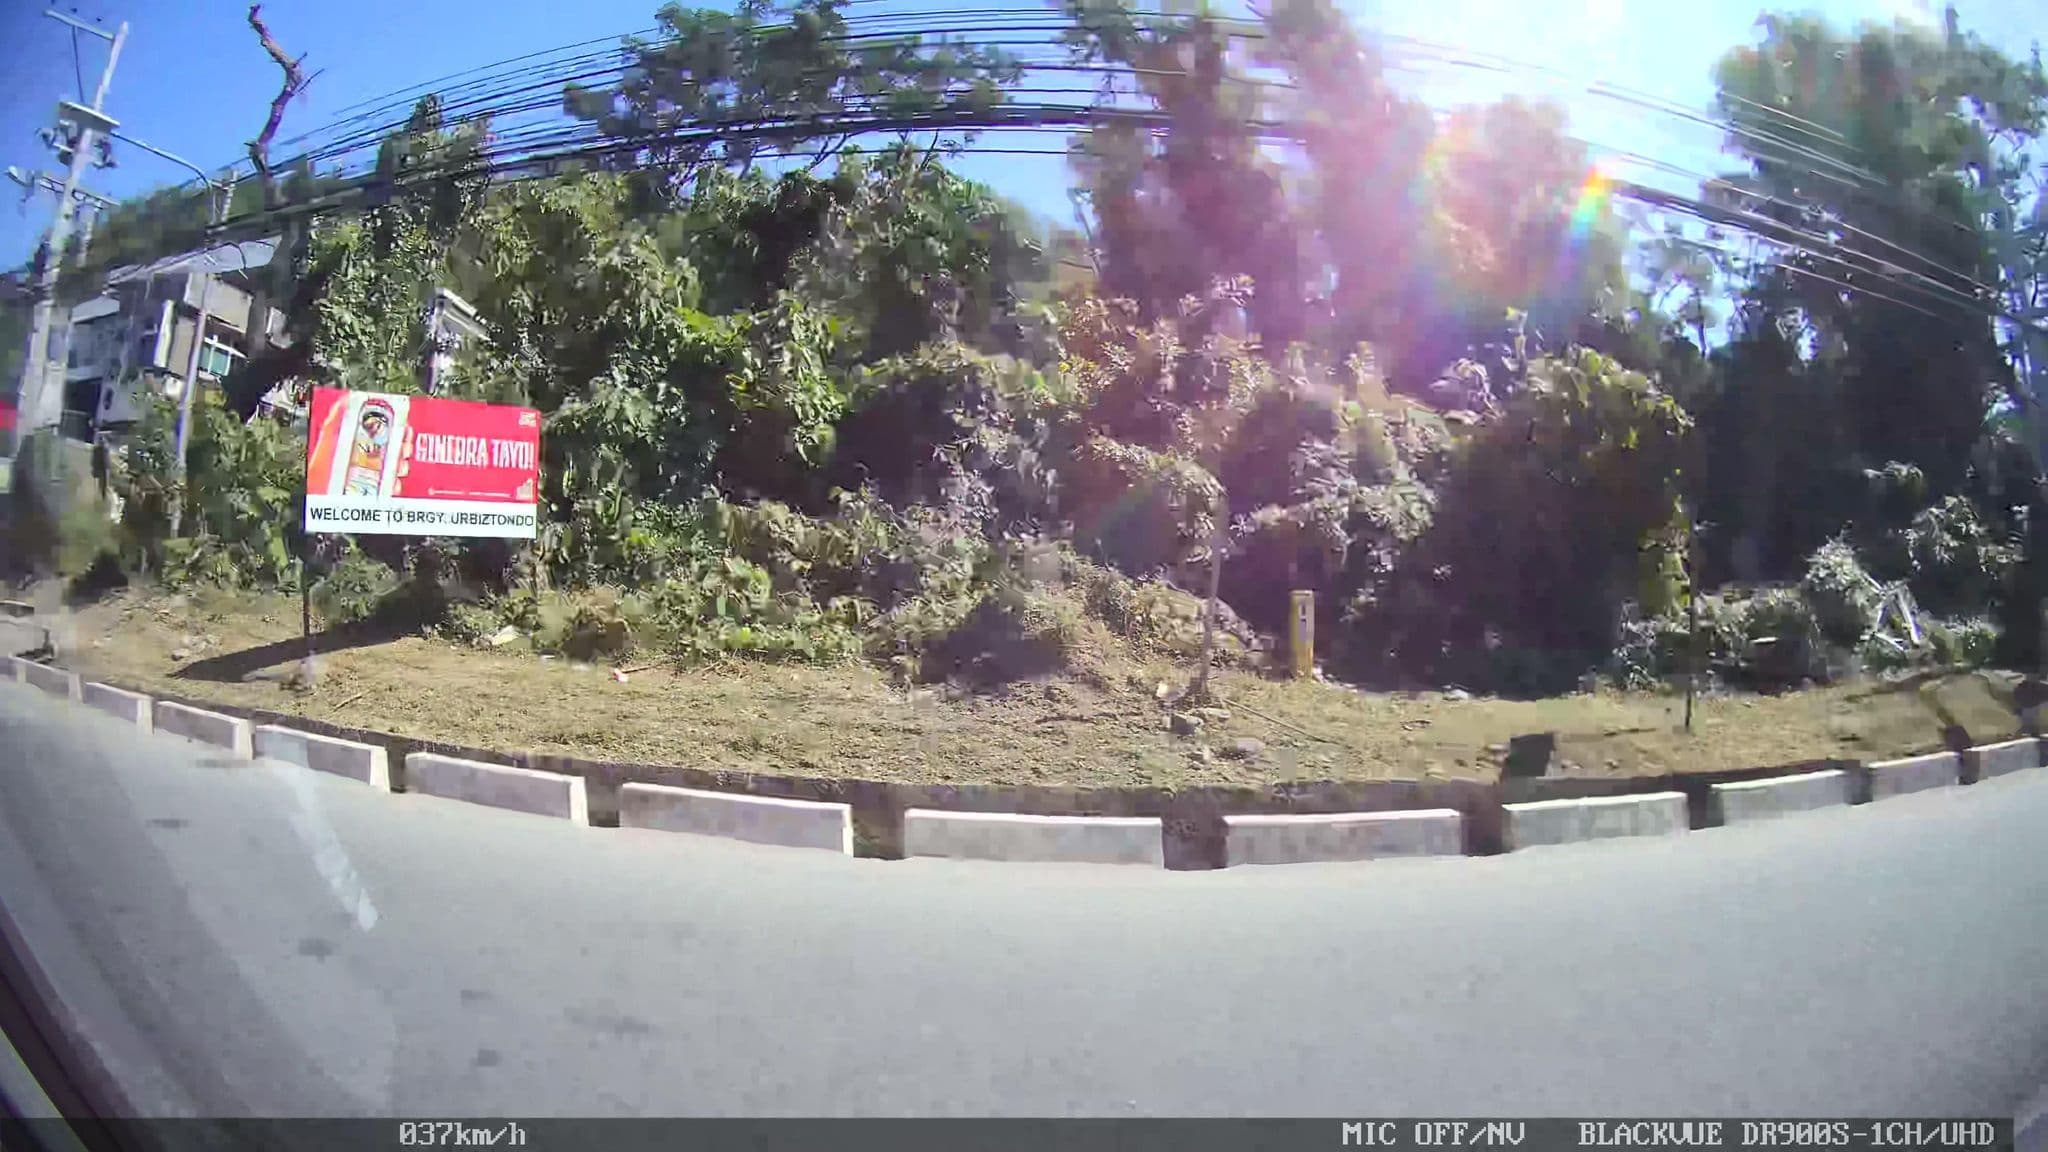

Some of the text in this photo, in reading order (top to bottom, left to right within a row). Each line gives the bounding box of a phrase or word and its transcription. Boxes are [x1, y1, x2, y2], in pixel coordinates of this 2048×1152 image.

[415, 432, 535, 470] GINEBRA TAYO!
[310, 506, 534, 527] WELCOME TO BRGY. URBIZTONDO
